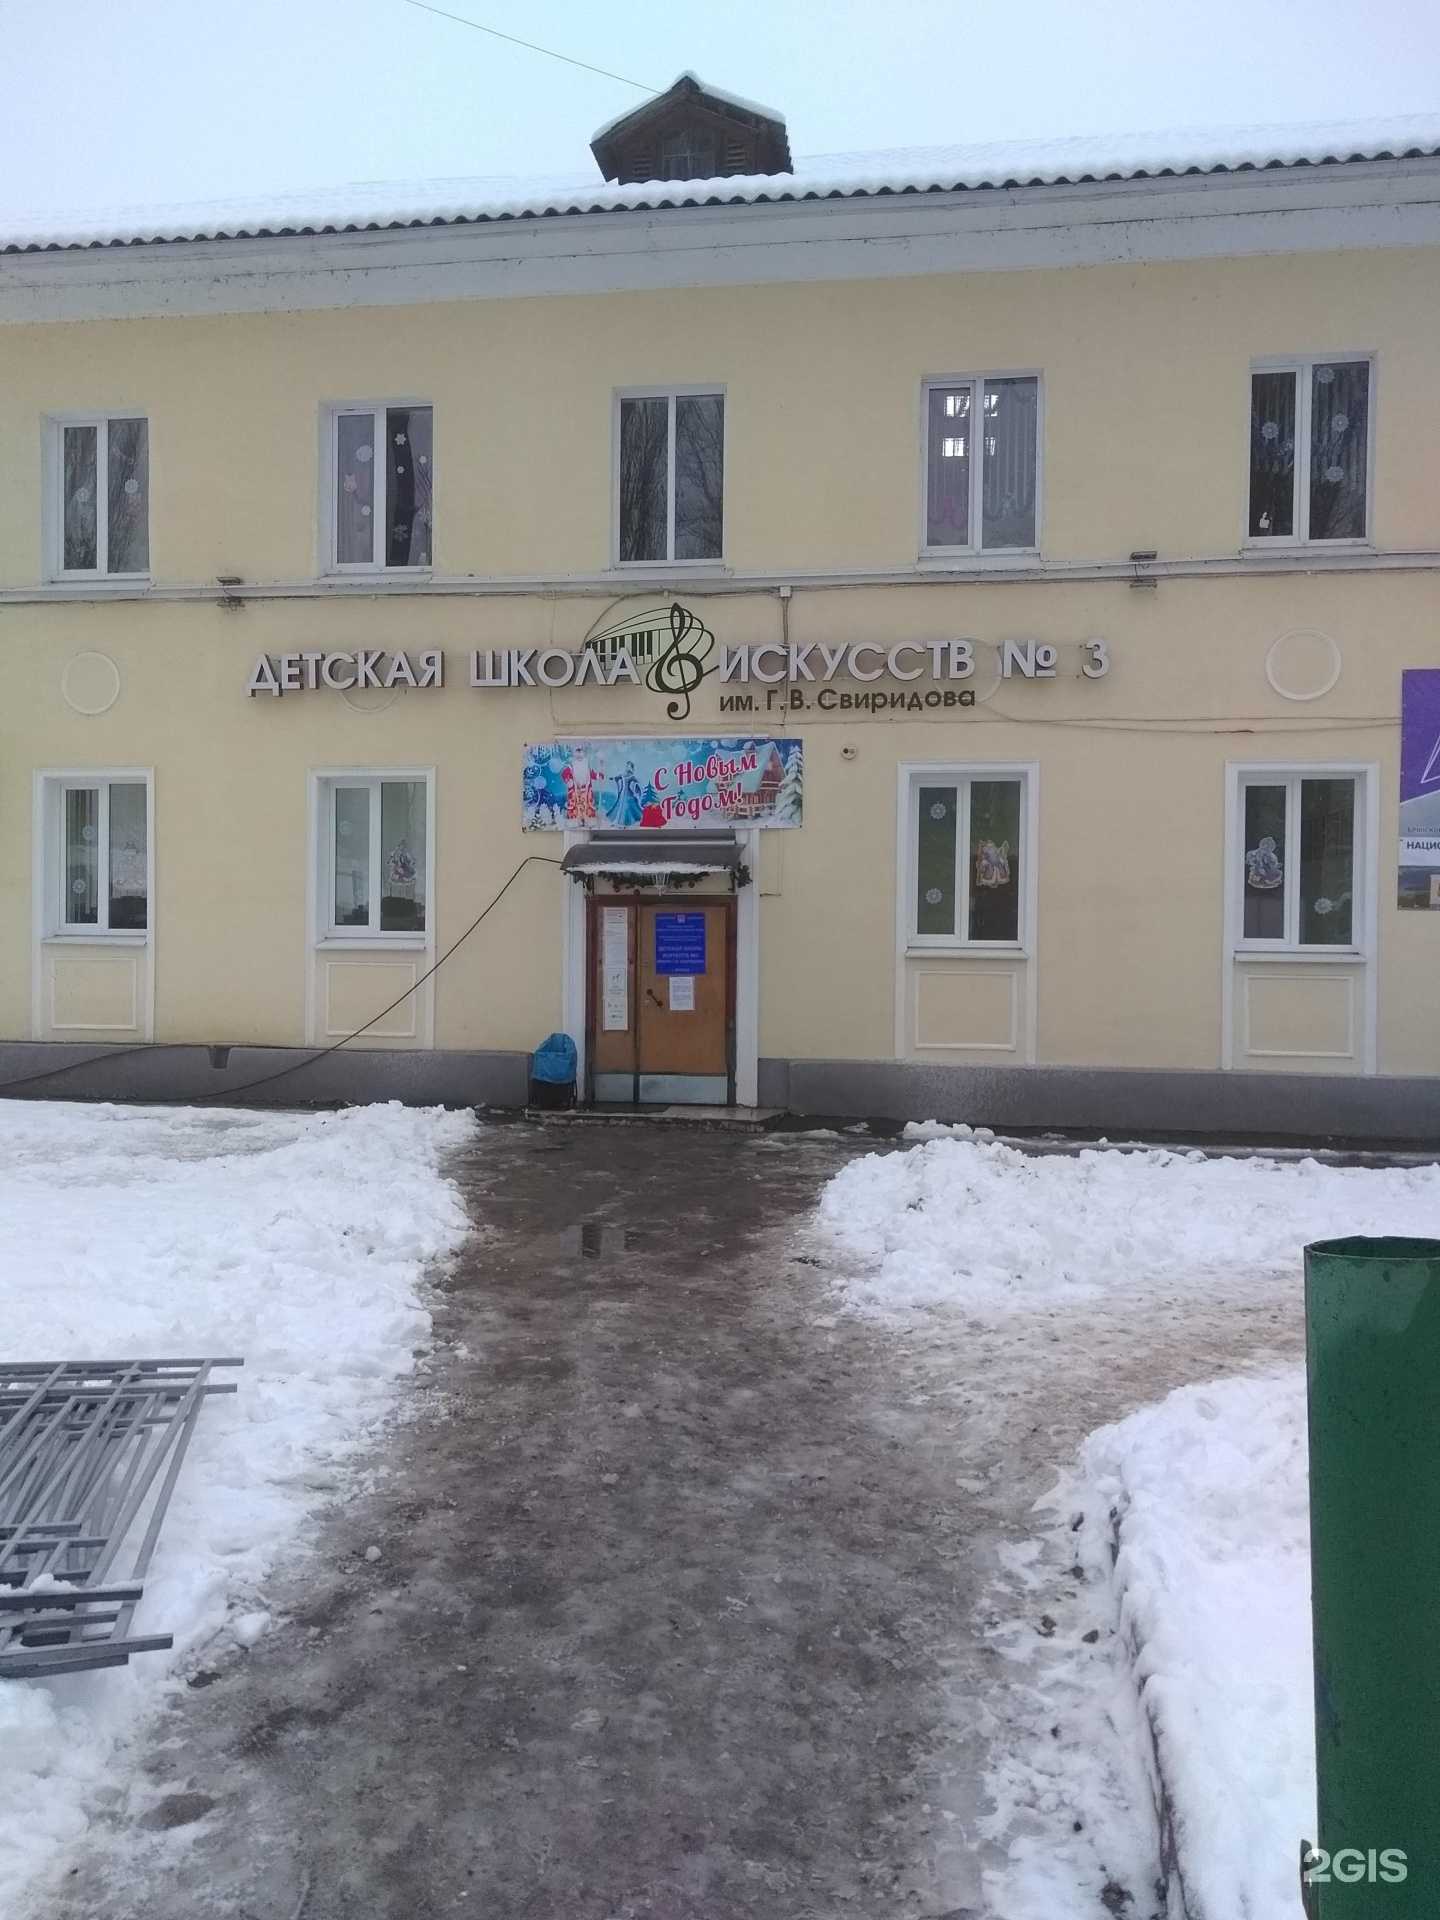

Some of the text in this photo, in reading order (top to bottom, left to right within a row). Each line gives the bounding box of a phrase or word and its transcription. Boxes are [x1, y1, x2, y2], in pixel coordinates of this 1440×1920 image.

[246, 638, 1111, 697] ДЕТСКАЯ ШКОЛА ИСКУССТВ № 3
[816, 688, 977, 714] Свиридова
[653, 751, 759, 792] С Новым
[659, 783, 744, 822] Годом!
